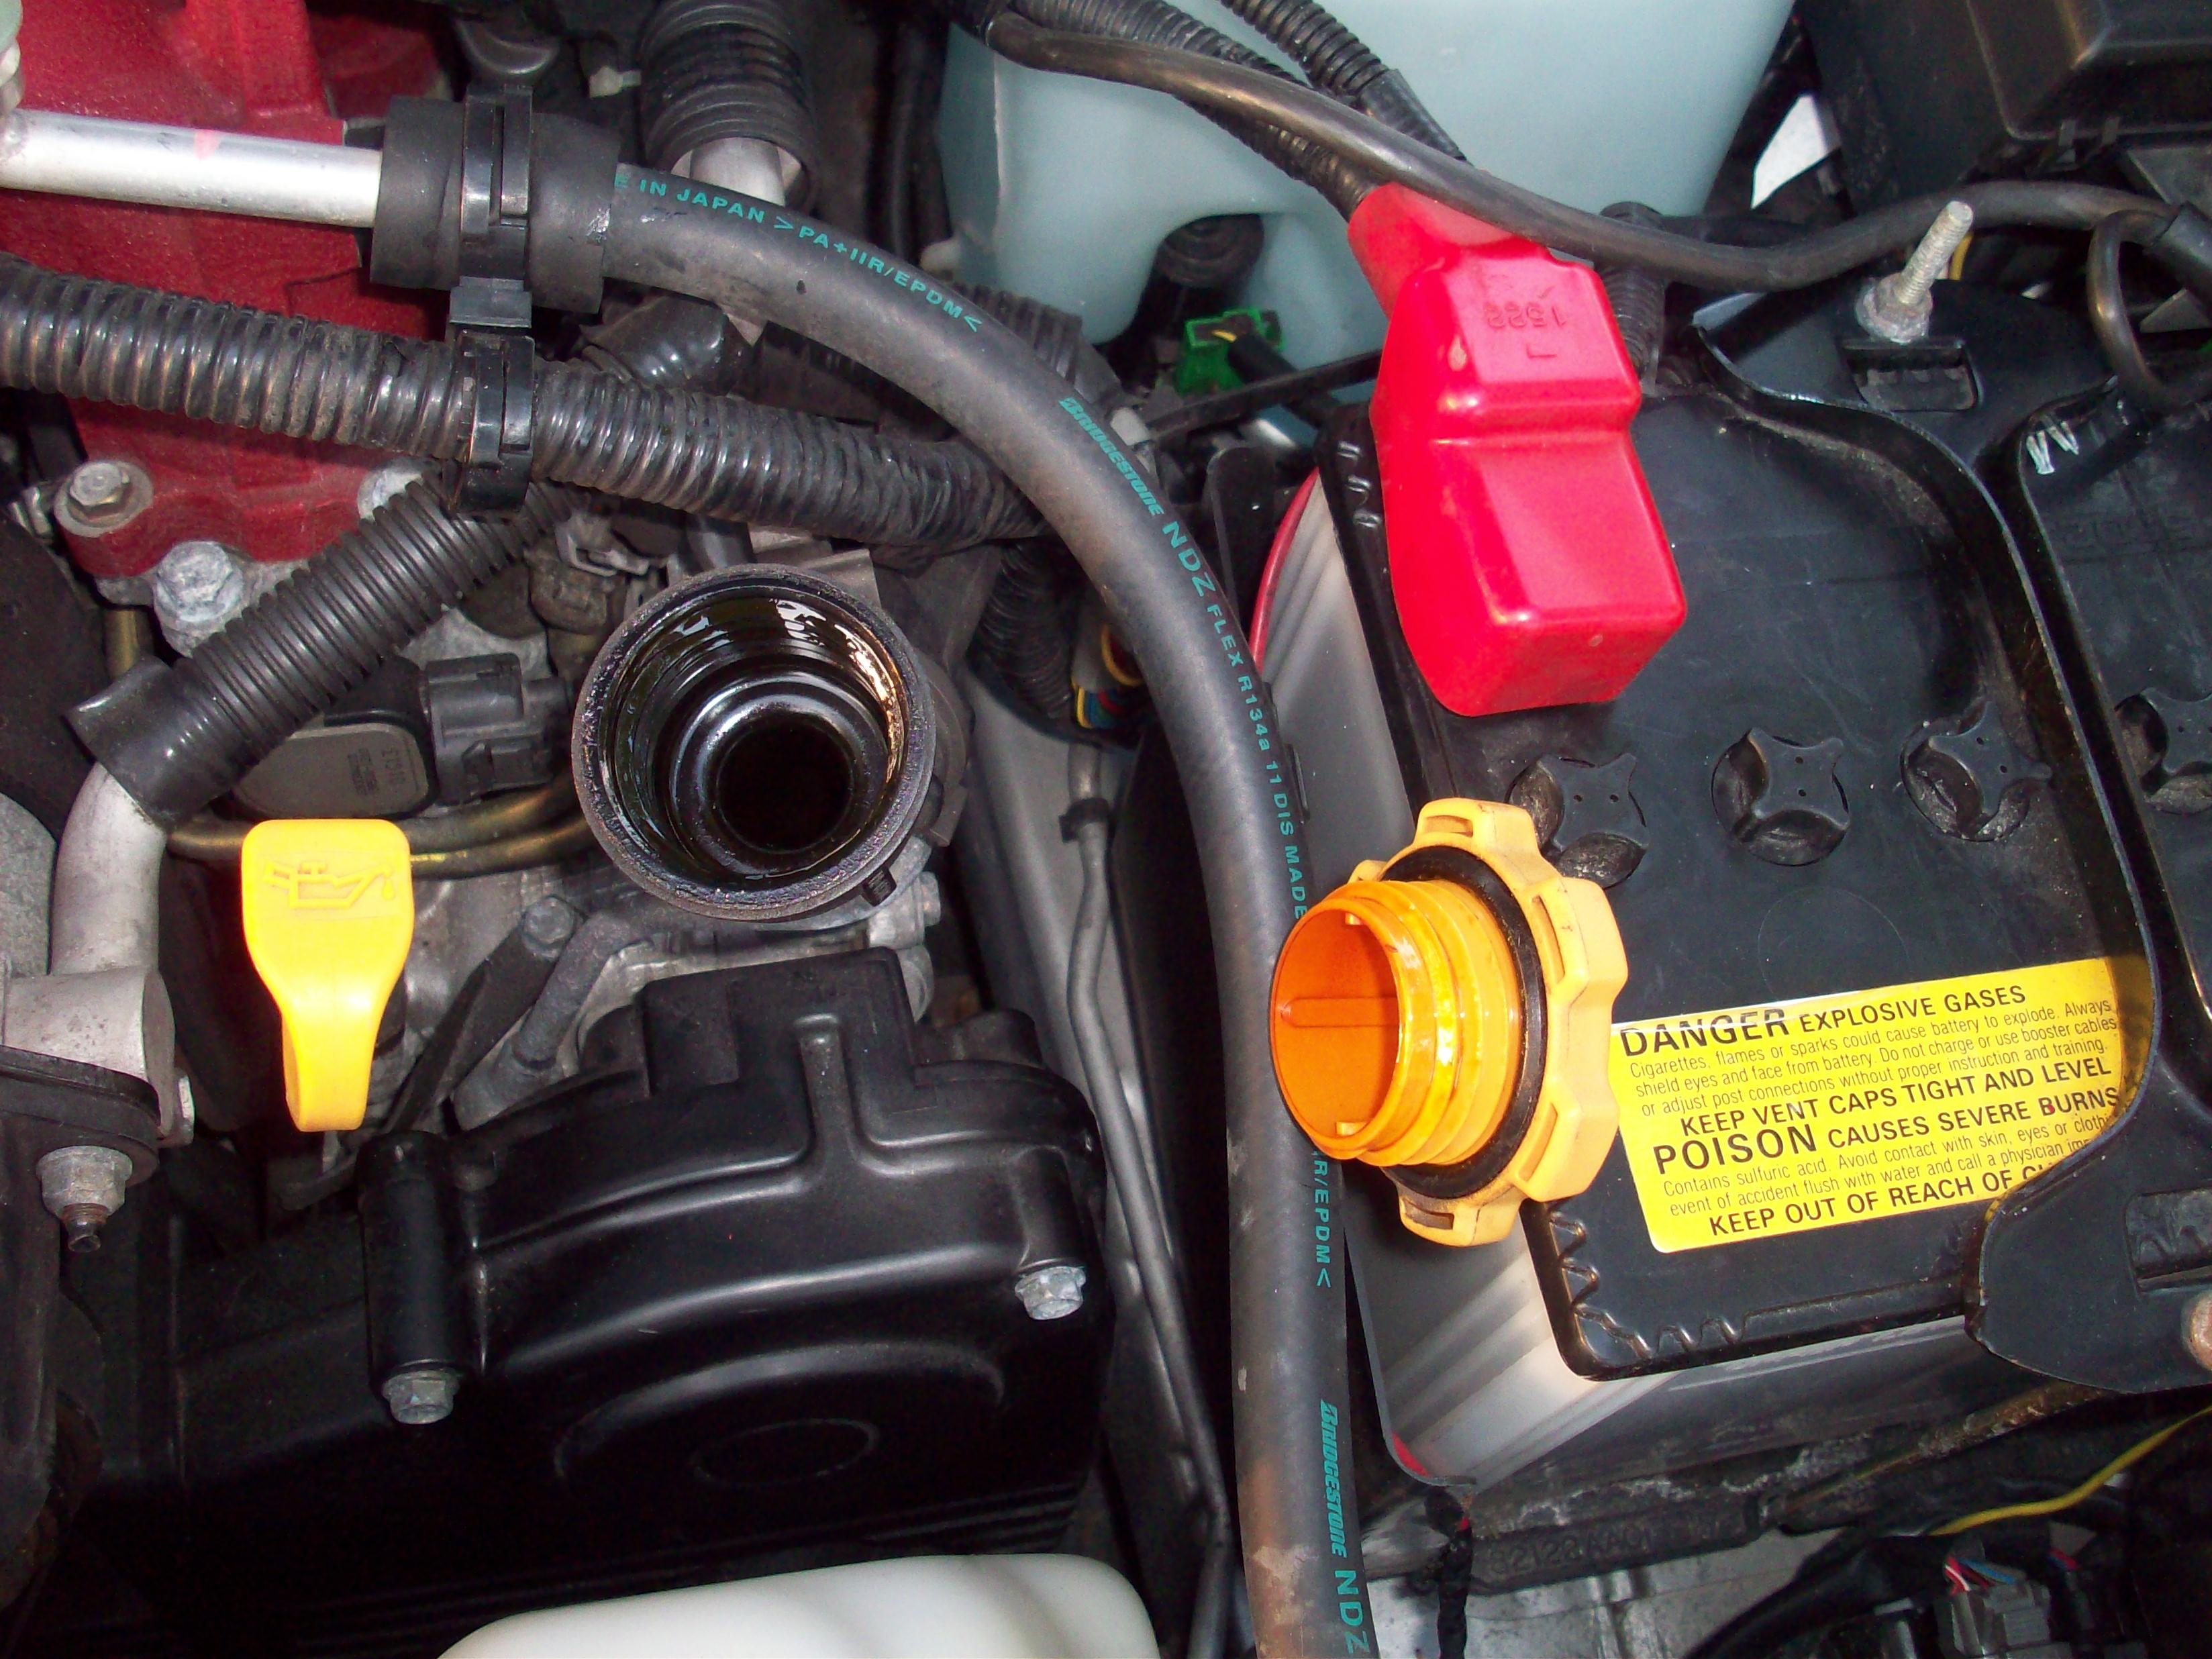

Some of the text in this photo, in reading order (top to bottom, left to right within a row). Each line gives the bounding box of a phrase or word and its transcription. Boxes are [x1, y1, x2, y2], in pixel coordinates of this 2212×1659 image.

[640, 179, 666, 196] IN
[676, 189, 765, 223] JAPAN
[1058, 397, 1165, 516] BRIDGESTONE
[1162, 520, 1216, 597] NDZ
[1207, 604, 1244, 667] FLEX
[1238, 675, 1270, 751] R134a
[1274, 793, 1294, 836] DIS
[1285, 846, 1307, 920] MADE
[1620, 985, 2025, 1056] DANGER EXPLOSIVE GASES
[1636, 1077, 1680, 1097] shield
[1685, 1074, 1718, 1092] eyes
[1723, 1068, 1748, 1085] and
[1752, 1066, 1782, 1080] face
[1786, 1060, 1819, 1075] from
[1879, 1048, 1899, 1062] Do
[1903, 1044, 1926, 1059] not
[1929, 1036, 1974, 1056] charge
[1978, 1036, 1992, 1048] or
[1997, 1032, 2019, 1046] use
[2021, 1023, 2070, 1042] booster
[2075, 1016, 2117, 1035] cables
[1716, 1048, 1764, 1065] flames
[1771, 1046, 1784, 1058] or
[1791, 1038, 1838, 1056] sparks
[1844, 1029, 1881, 1048] could
[1887, 1026, 1927, 1042] cause
[1931, 1017, 1979, 1035] battery
[1984, 1015, 1998, 1028] to
[2004, 1006, 2060, 1027] explode.
[2065, 1000, 2111, 1017] Always
[1642, 1103, 1655, 1116] or
[1662, 1094, 1707, 1114] adjust
[1713, 1088, 1744, 1109] post
[1749, 1077, 1835, 1101] connections
[1839, 1067, 1893, 1087] without
[1898, 1062, 1942, 1081] proper
[1948, 1052, 2019, 1072] instruction
[2025, 1045, 2049, 1061] and
[1680, 1057, 2111, 1136] KEEP VENT CAPS TIGHT AND LEVEL
[1653, 1087, 2119, 1174] POISON CAUSES SEVERE BURNS
[1664, 1175, 1730, 1196] Contains
[1737, 1164, 1791, 1185] sulfuric
[1839, 1150, 1878, 1169] Avoid
[1884, 1141, 1937, 1162] contact
[1942, 1136, 1973, 1153] with
[2018, 1125, 2050, 1145] eyes
[2055, 1121, 2066, 1135] or
[1670, 1197, 1711, 1216] event
[1717, 1192, 1731, 1209] of
[1739, 1183, 1799, 1205] accident
[1804, 1177, 1840, 1195] flush
[1844, 1171, 1876, 1188] with
[1880, 1165, 1920, 1183] water
[1927, 1158, 1952, 1175] and
[1958, 1154, 1981, 1170] call
[1988, 1154, 1995, 1166] a
[2001, 1143, 2064, 1168] physician
[1709, 1208, 1774, 1236] KEEP
[1785, 1198, 1836, 1223] OUT
[1847, 1191, 1878, 1213] OF
[1888, 1176, 1974, 1207] REACH
[1982, 1169, 2013, 1193] OF
[1320, 1399, 1370, 1654] BRIDGESTONE NDZ
